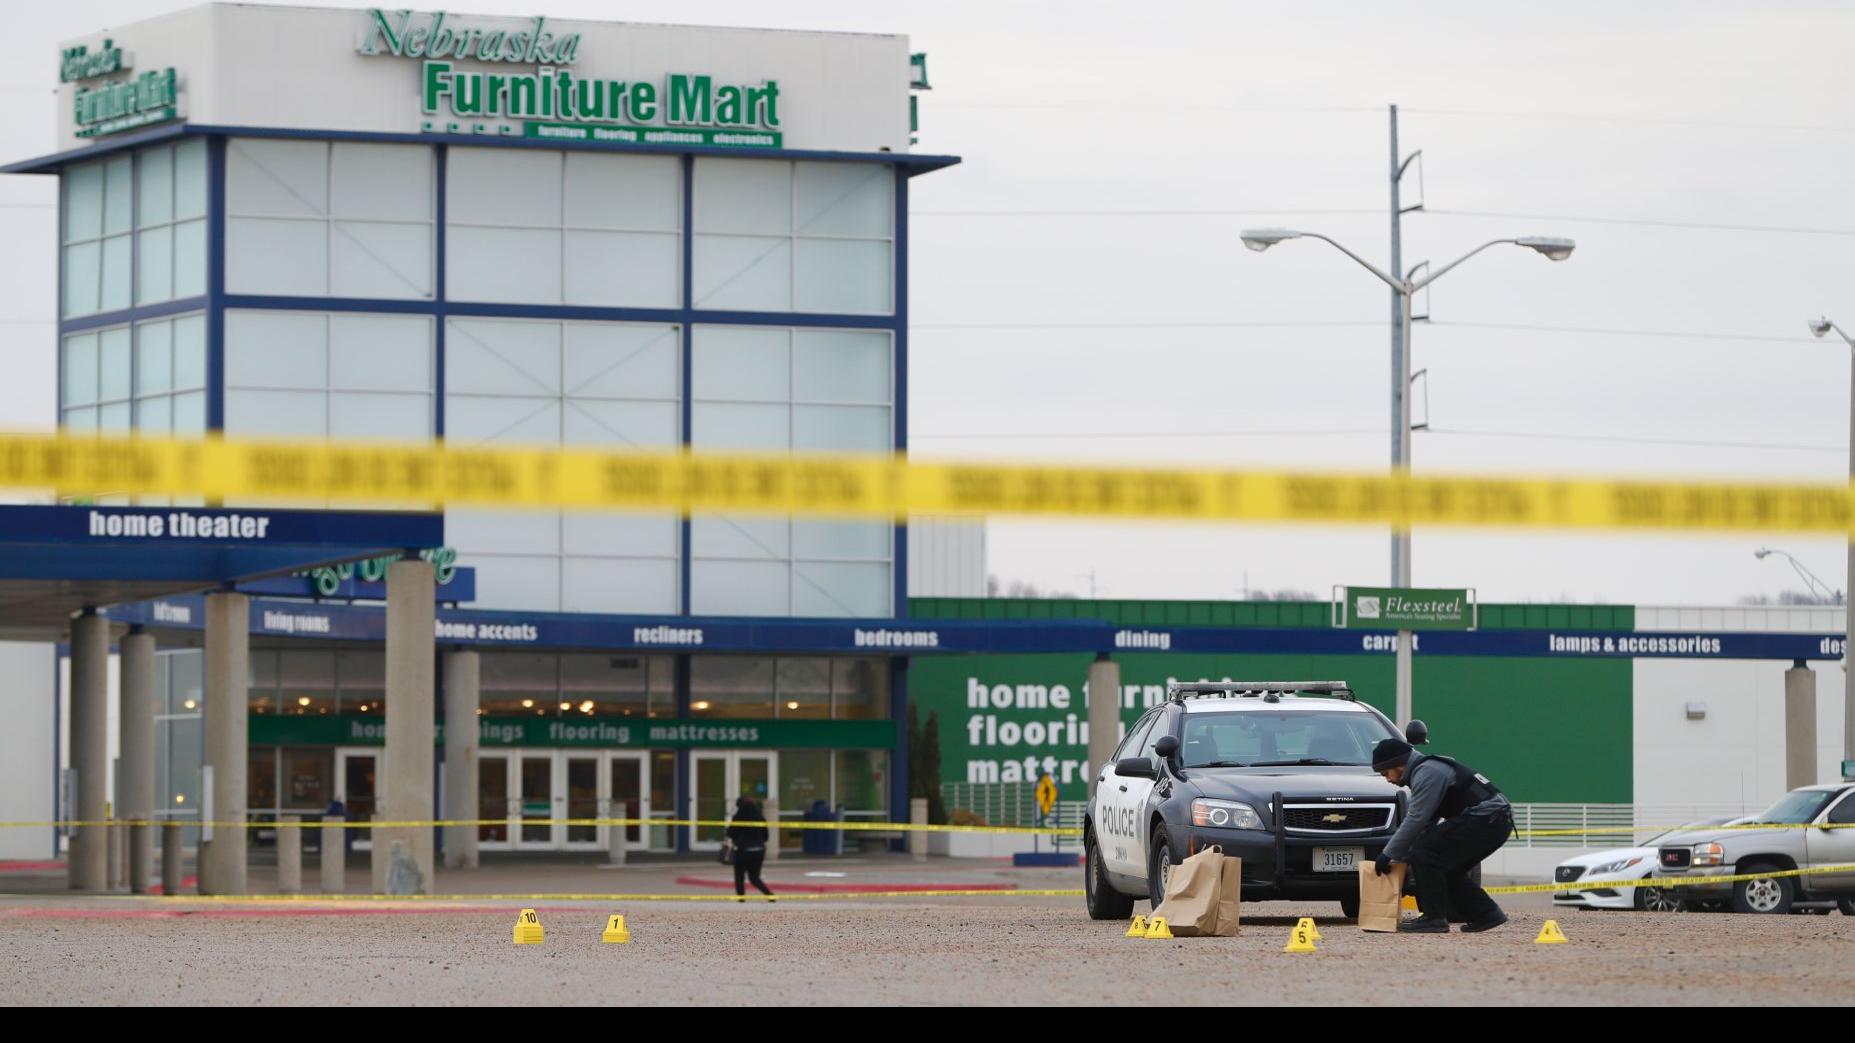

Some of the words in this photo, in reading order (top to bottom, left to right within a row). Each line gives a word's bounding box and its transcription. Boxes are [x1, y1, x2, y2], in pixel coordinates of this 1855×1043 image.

[359, 8, 582, 65] Nebraska
[421, 59, 657, 125] Furniture
[666, 73, 782, 131] Mart
[89, 510, 164, 537] home
[168, 512, 269, 538] theater
[1386, 597, 1461, 612] Flexsteel
[435, 620, 476, 639] home
[478, 624, 537, 640] accents
[634, 627, 703, 644] recliners
[854, 629, 938, 646] bedrooms
[1115, 630, 1170, 649] dining
[1362, 634, 1419, 652] carpt
[1550, 634, 1600, 653] lamps
[1603, 637, 1615, 651] &
[1618, 636, 1721, 653] accessories
[1820, 638, 1847, 655] des
[967, 677, 1071, 709] home
[550, 723, 630, 743] flooring
[650, 725, 759, 741] mattresses
[967, 714, 1125, 745] floori
[967, 756, 1089, 784] mattr
[1102, 805, 1135, 838] POLICE
[1324, 853, 1354, 866] 31657
[525, 912, 537, 924] 10
[613, 918, 619, 929] 1
[1154, 920, 1162, 932] 7
[1298, 931, 1306, 944] 5
